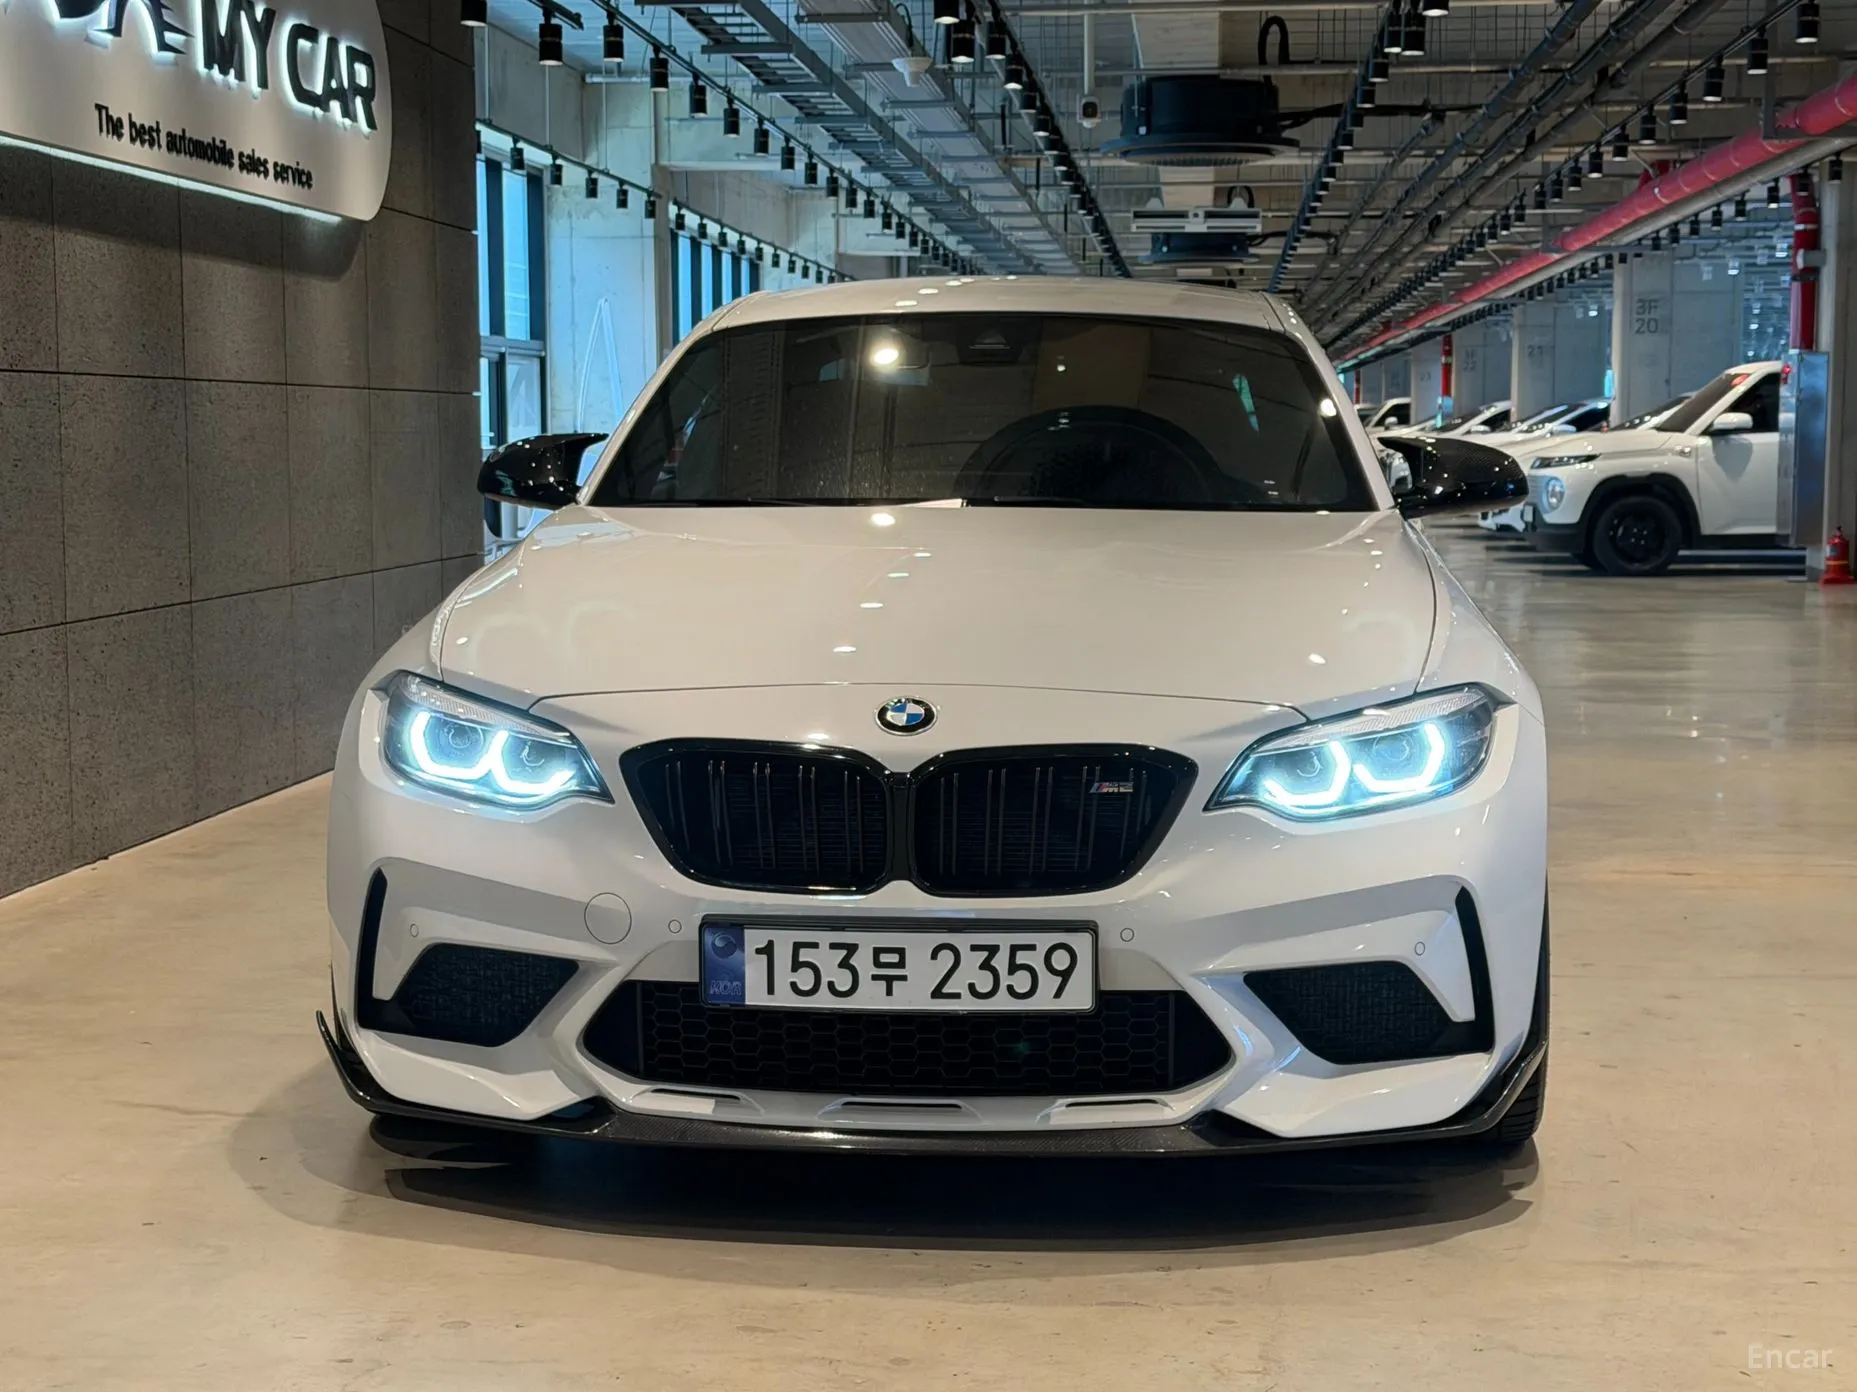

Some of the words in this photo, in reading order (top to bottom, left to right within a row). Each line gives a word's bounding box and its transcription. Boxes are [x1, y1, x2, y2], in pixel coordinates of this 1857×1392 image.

[201, 0, 276, 90] MY
[286, 23, 378, 131] CAR
[94, 102, 124, 141] The
[128, 112, 162, 151] best
[166, 128, 235, 171] automobile
[238, 148, 269, 180] sales
[273, 160, 314, 190] service
[1634, 317, 1659, 334] 20
[1635, 298, 1660, 316] 3F
[754, 939, 909, 998] 153무
[929, 941, 1079, 1001] 2359
